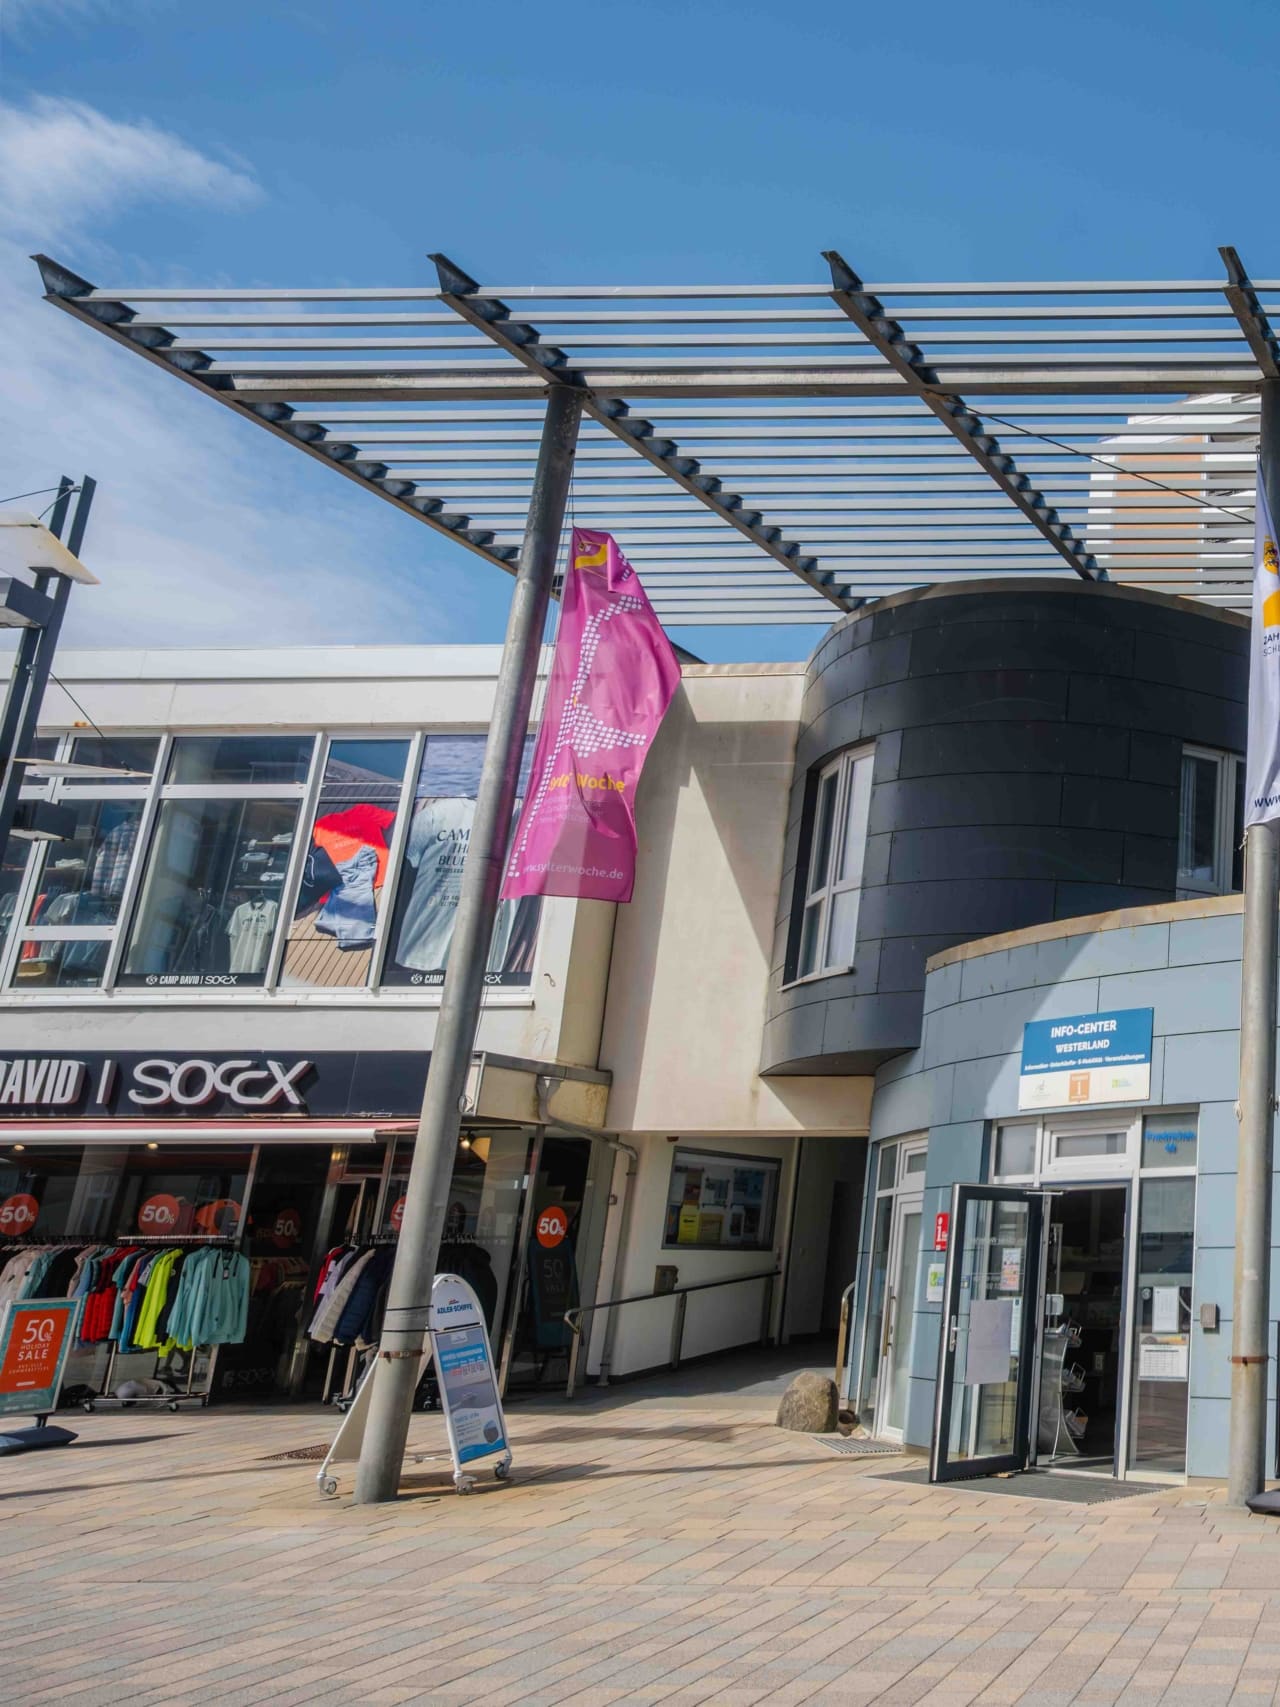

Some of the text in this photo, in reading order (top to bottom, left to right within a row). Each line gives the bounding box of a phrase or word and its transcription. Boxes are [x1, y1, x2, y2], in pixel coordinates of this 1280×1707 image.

[436, 828, 471, 842] CAM
[159, 975, 179, 985] CAMP
[180, 975, 200, 985] DAVID
[424, 974, 444, 984] CAMP
[1050, 1020, 1117, 1039] INFO-CENTER
[1055, 1039, 1110, 1054] WESTERLAND
[142, 1205, 175, 1224] 50%
[539, 1218, 565, 1236] 50%
[437, 1303, 473, 1314] ADLER-SCHIFFE
[17, 1349, 48, 1361] SALE
